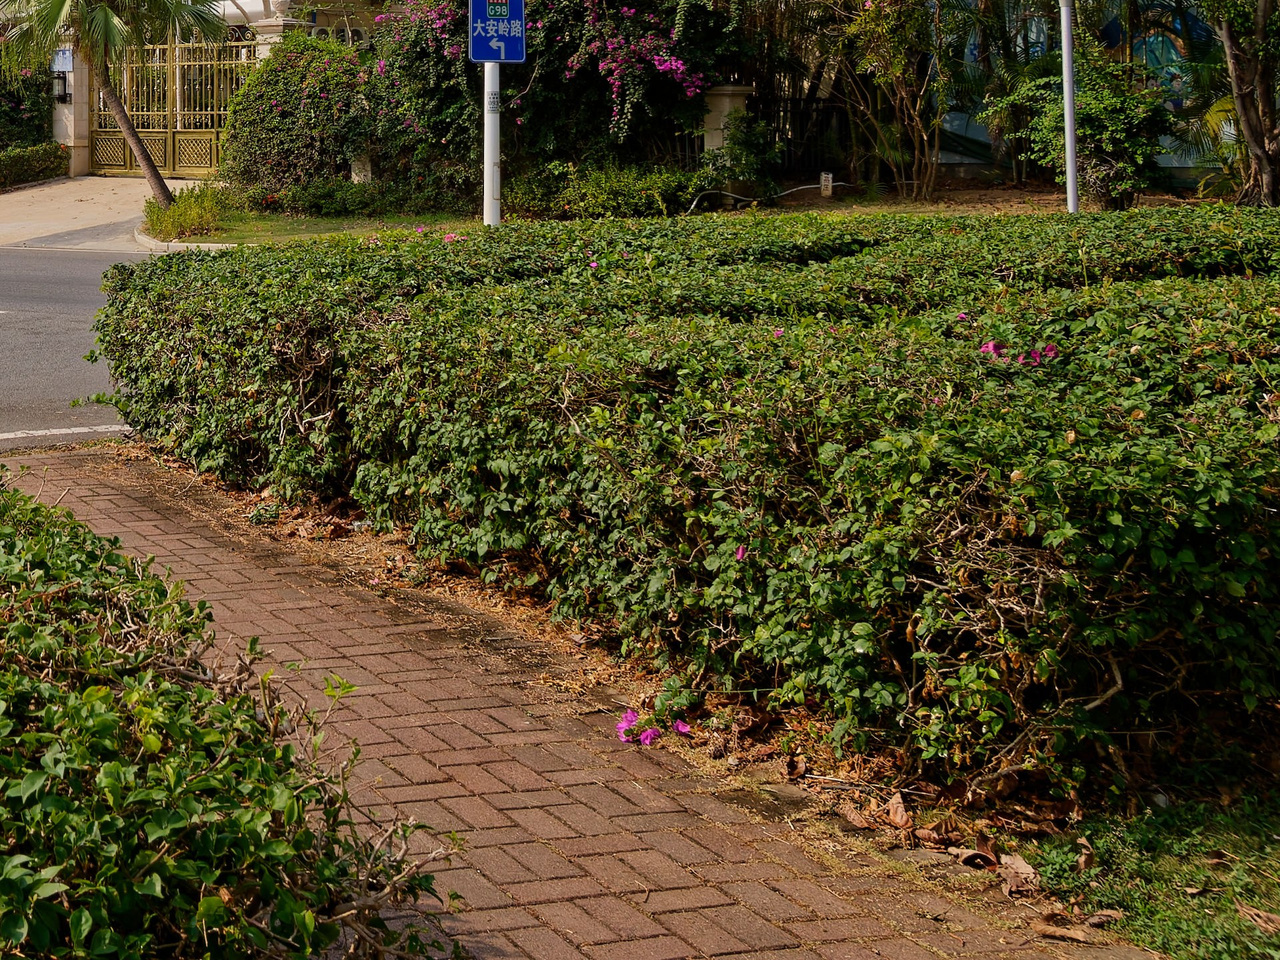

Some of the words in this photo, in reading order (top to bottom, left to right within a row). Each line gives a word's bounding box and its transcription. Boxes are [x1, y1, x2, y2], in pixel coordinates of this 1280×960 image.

[488, 5, 508, 15] G98
[473, 19, 522, 37] 大安岭路
